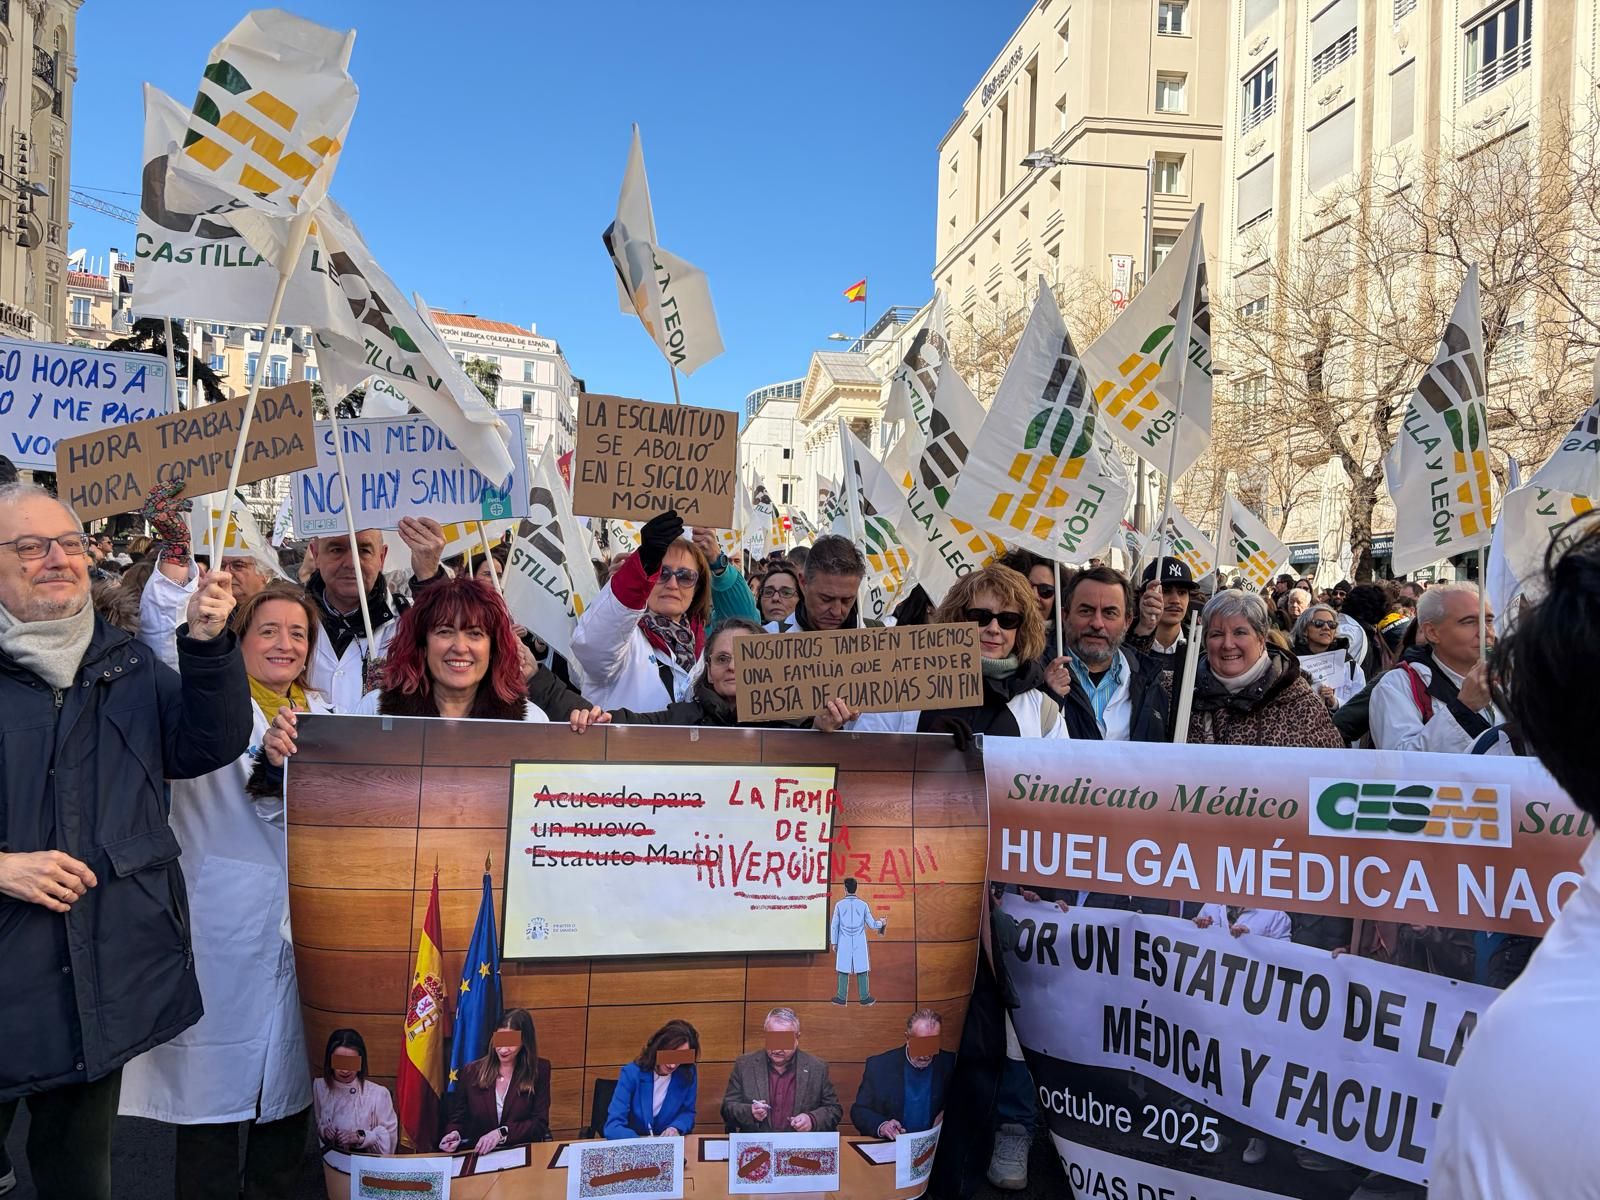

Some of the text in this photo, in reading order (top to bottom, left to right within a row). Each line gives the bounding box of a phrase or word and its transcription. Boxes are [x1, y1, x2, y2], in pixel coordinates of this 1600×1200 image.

[461, 331, 485, 340] MÉDICA
[485, 334, 517, 344] COLEGIAL
[527, 339, 550, 349] ESPAÑA
[32, 353, 117, 391] HORAS
[122, 365, 146, 395] A
[53, 396, 92, 422] ME
[101, 402, 169, 424] PAGA
[585, 400, 725, 441] LA ESCLAVITUD
[69, 431, 142, 473] HORA
[324, 425, 371, 456] SIN
[596, 433, 715, 462] SE ABOLIÓ
[70, 433, 304, 508] HORA COMPUTADA
[303, 471, 349, 515] NO
[361, 469, 400, 511] HAY
[410, 463, 513, 504] SANIDAD
[582, 459, 608, 484] EN
[616, 461, 635, 488] EL
[641, 463, 699, 491] SIGLO
[701, 467, 732, 496] XIX
[611, 490, 700, 514] MÓNICA
[1430, 477, 1455, 547] LEÓN
[510, 547, 570, 607] STILLA
[939, 540, 975, 578] LEÓ
[740, 627, 974, 662] NOSOTROS TAMBIÉN TENEMOS
[742, 652, 971, 685] UNA FAMILIA QUE ATENDER
[750, 684, 804, 716] BASTA
[812, 683, 830, 711] DE
[926, 672, 953, 700] SIN
[959, 671, 980, 700] FIN
[534, 784, 702, 815] Acuerdo para
[729, 780, 765, 809] LA
[1008, 773, 1158, 810] Sindicato
[1168, 783, 1298, 820] Médico
[1316, 782, 1499, 840] CESM
[534, 821, 646, 838] un nuevo
[775, 818, 851, 851] DE LA
[531, 843, 720, 867] Estatuto Marco
[1001, 827, 1201, 890] HUELGA
[1216, 838, 1439, 913] MÉDICA
[1014, 918, 1478, 1067] OR UN ESTATUTO DE LA
[1102, 999, 1443, 1165] MÉDICA Y FACUL
[1039, 1085, 1219, 1154] octubre 2025
